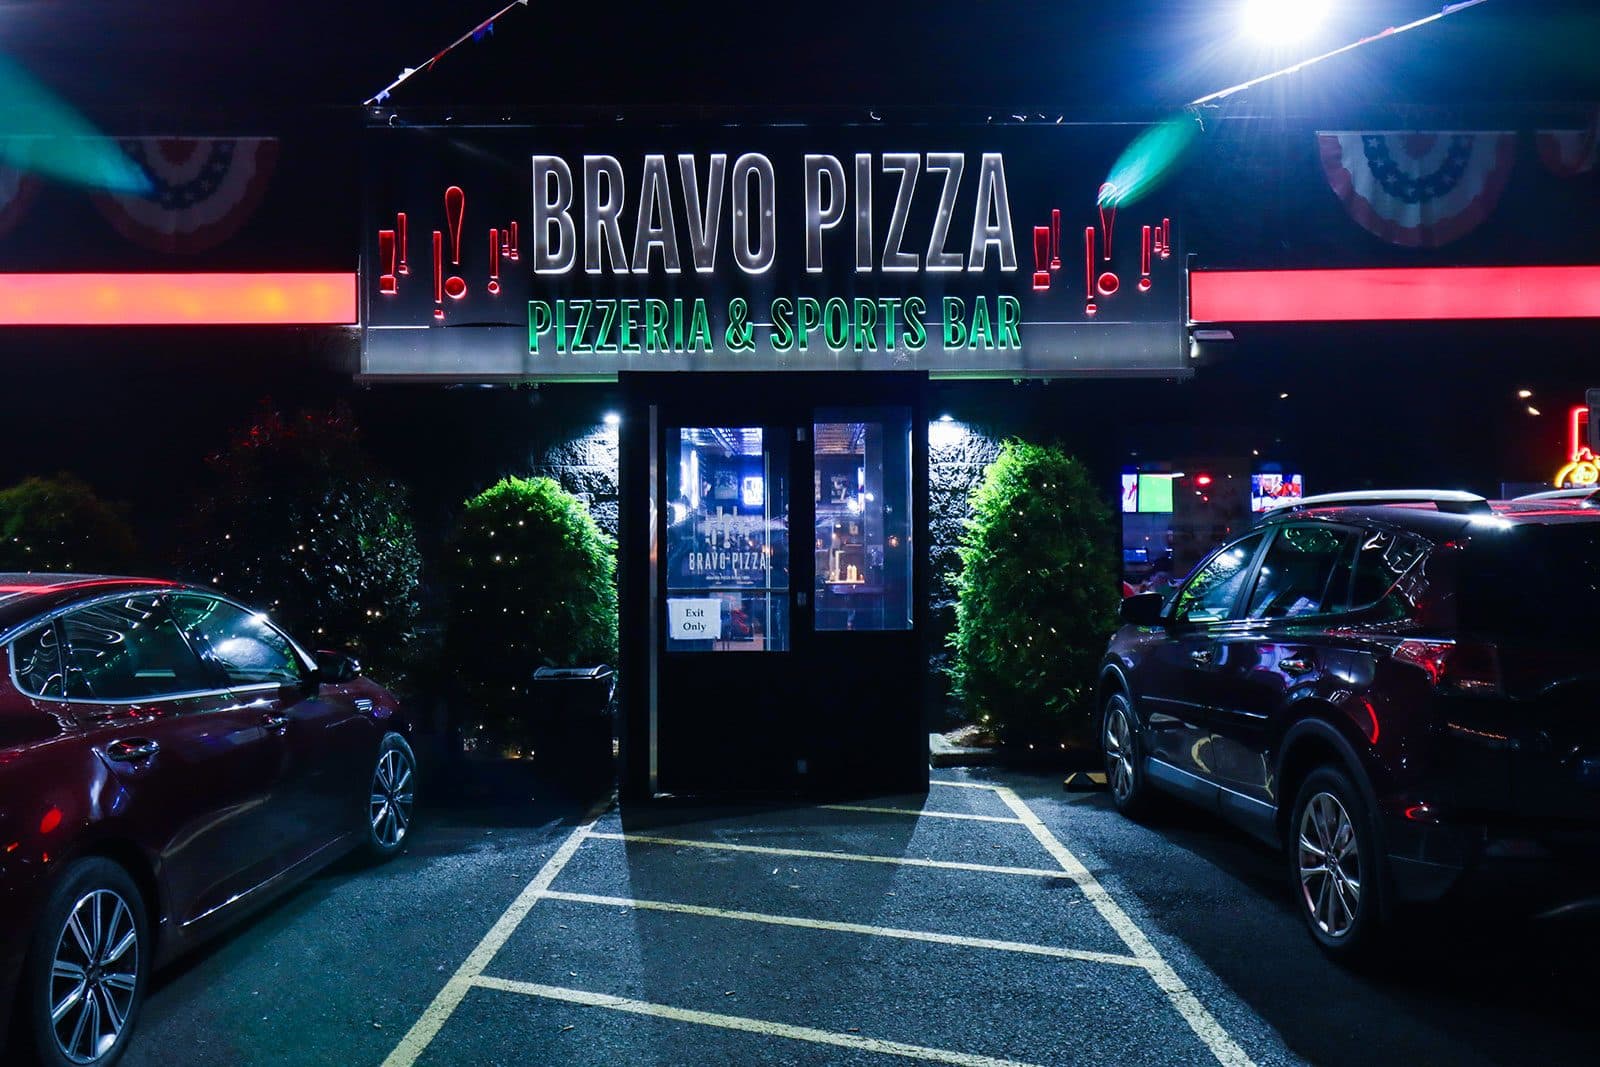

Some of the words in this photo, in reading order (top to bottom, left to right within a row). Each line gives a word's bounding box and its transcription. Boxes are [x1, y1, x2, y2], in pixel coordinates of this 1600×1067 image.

[532, 152, 776, 274] BRAVO
[804, 152, 1018, 273] PIZZA
[527, 298, 714, 355] PIZZERIA
[725, 298, 756, 353] &
[770, 296, 927, 353] SPORTS
[942, 295, 1022, 351] BAR
[689, 552, 726, 570] BRAVO
[732, 552, 768, 570] PIZZA
[685, 608, 704, 617] Exit
[682, 622, 706, 632] Only
